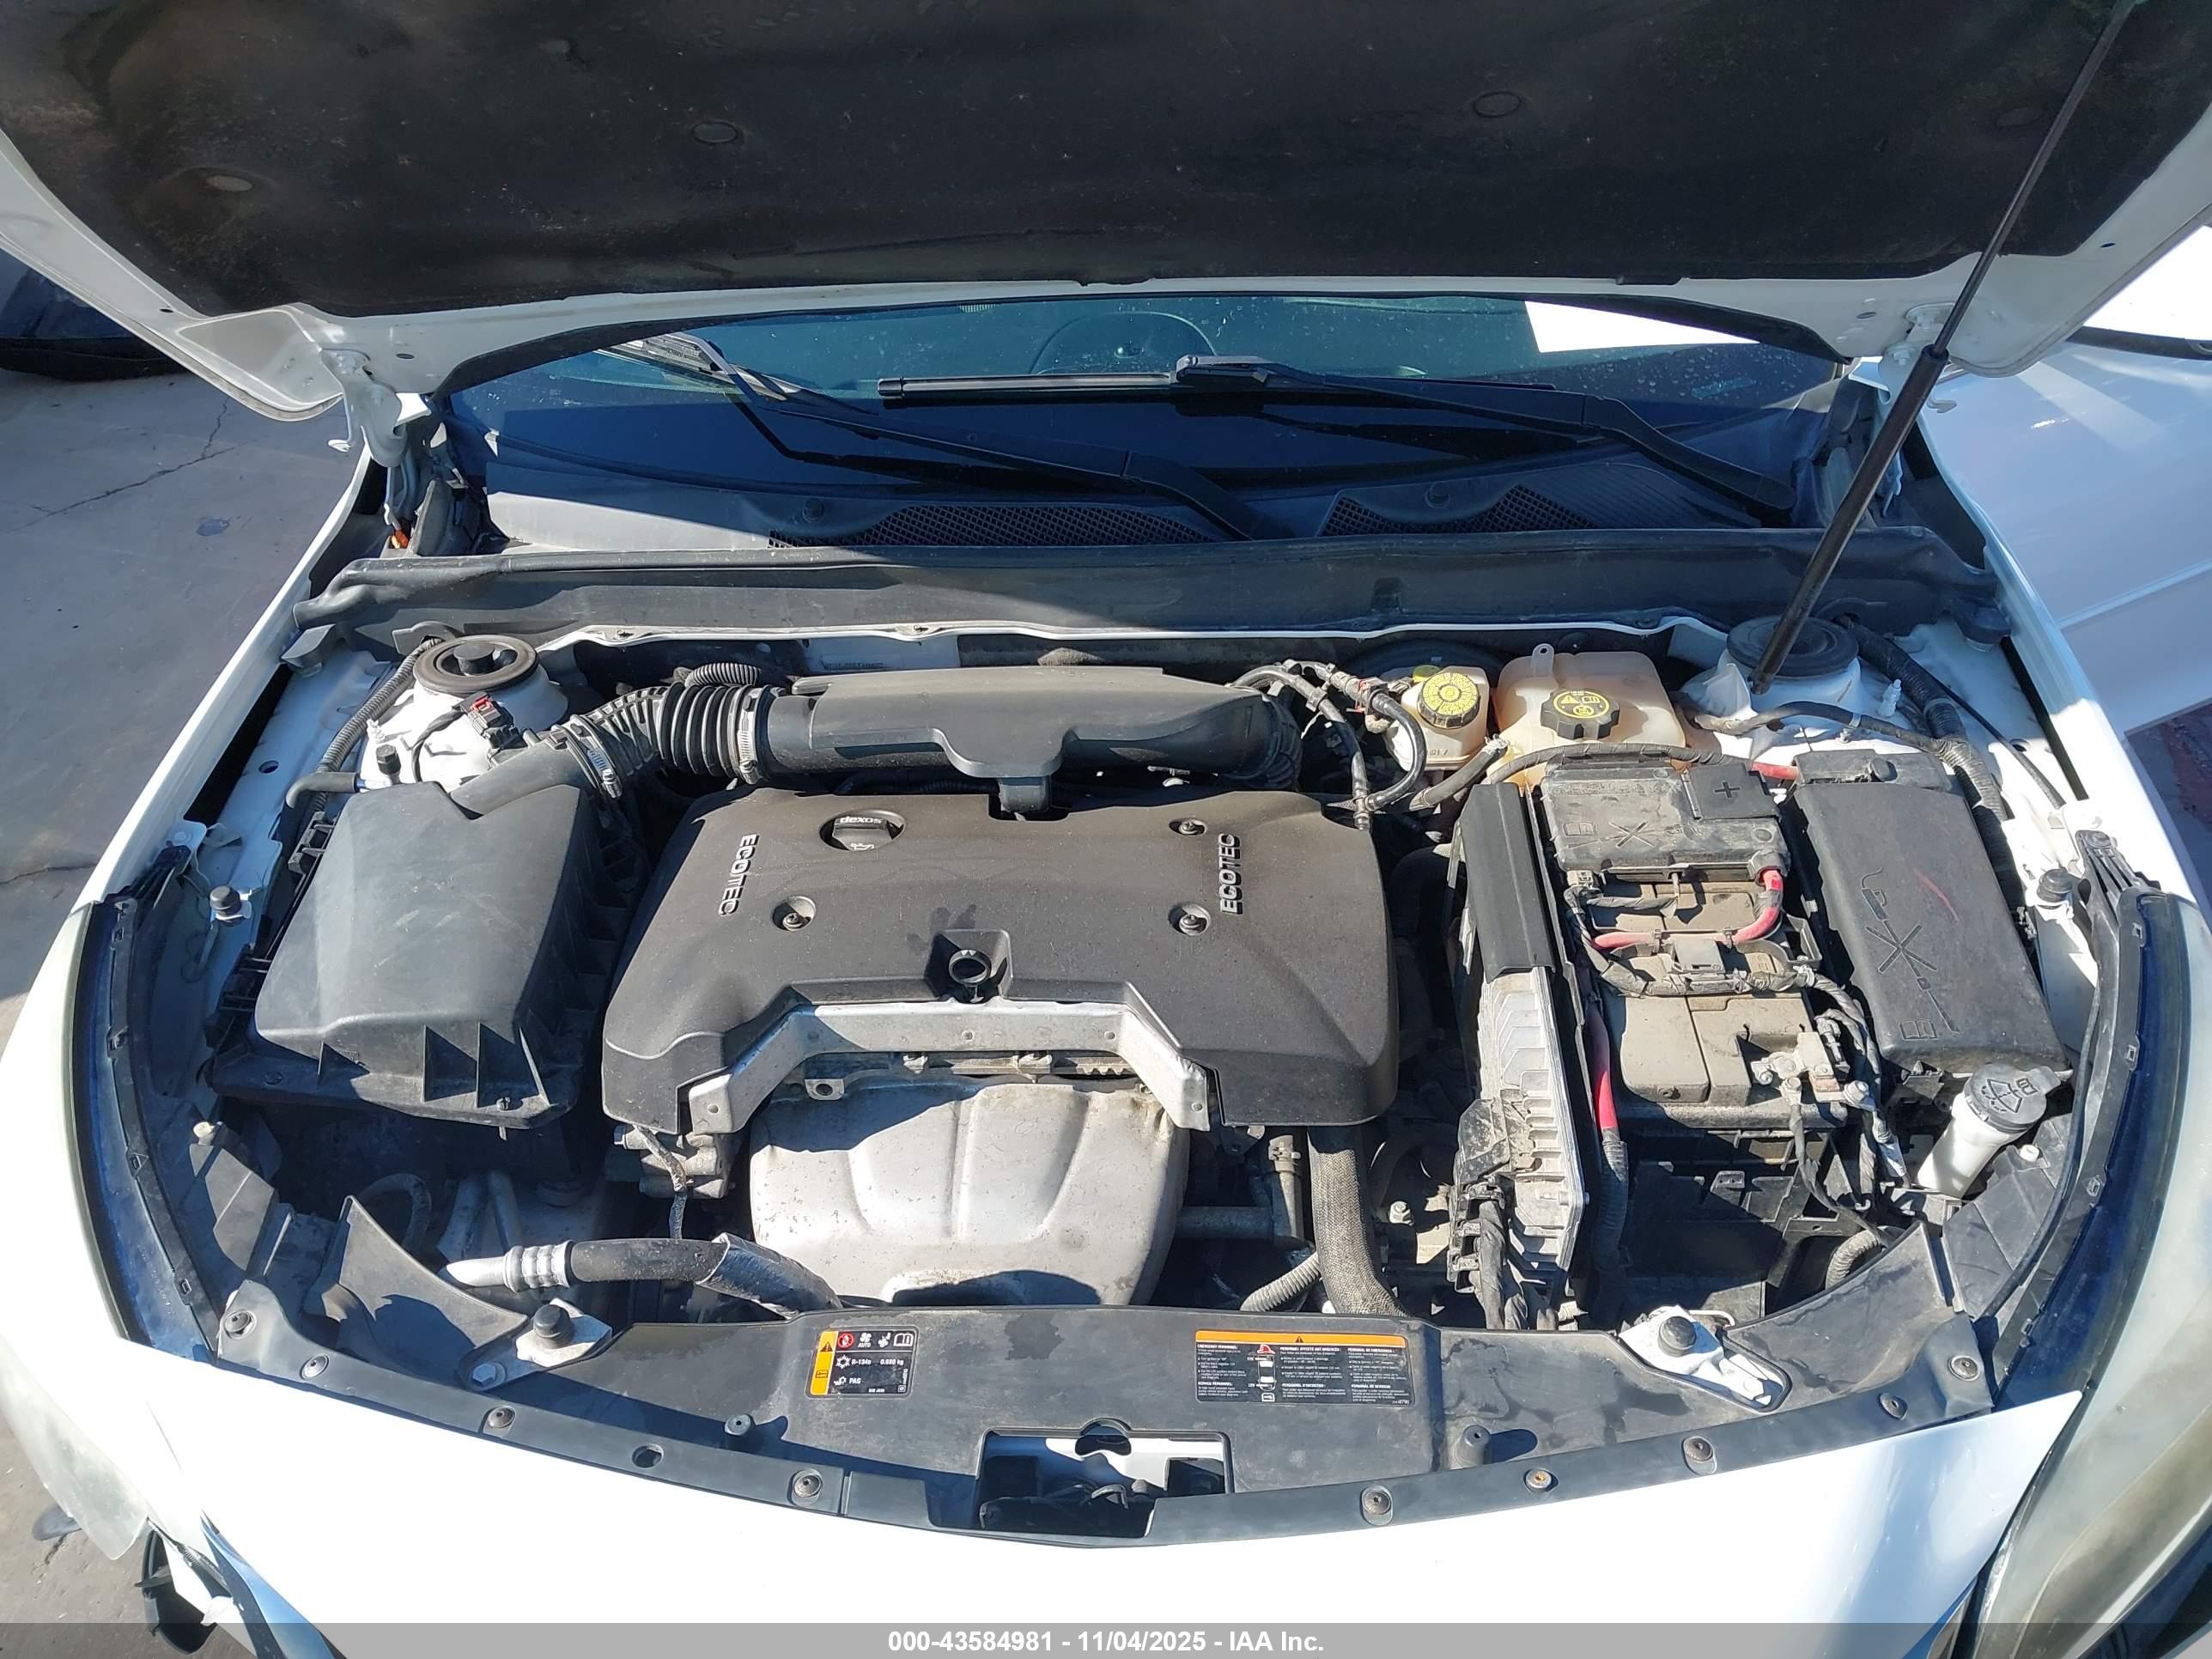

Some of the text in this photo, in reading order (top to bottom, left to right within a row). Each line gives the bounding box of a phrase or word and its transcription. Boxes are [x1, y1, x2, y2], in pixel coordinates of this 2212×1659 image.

[840, 815, 882, 824] dexos
[719, 834, 758, 915] ECOTEC
[1218, 833, 1241, 914] ECOTEC
